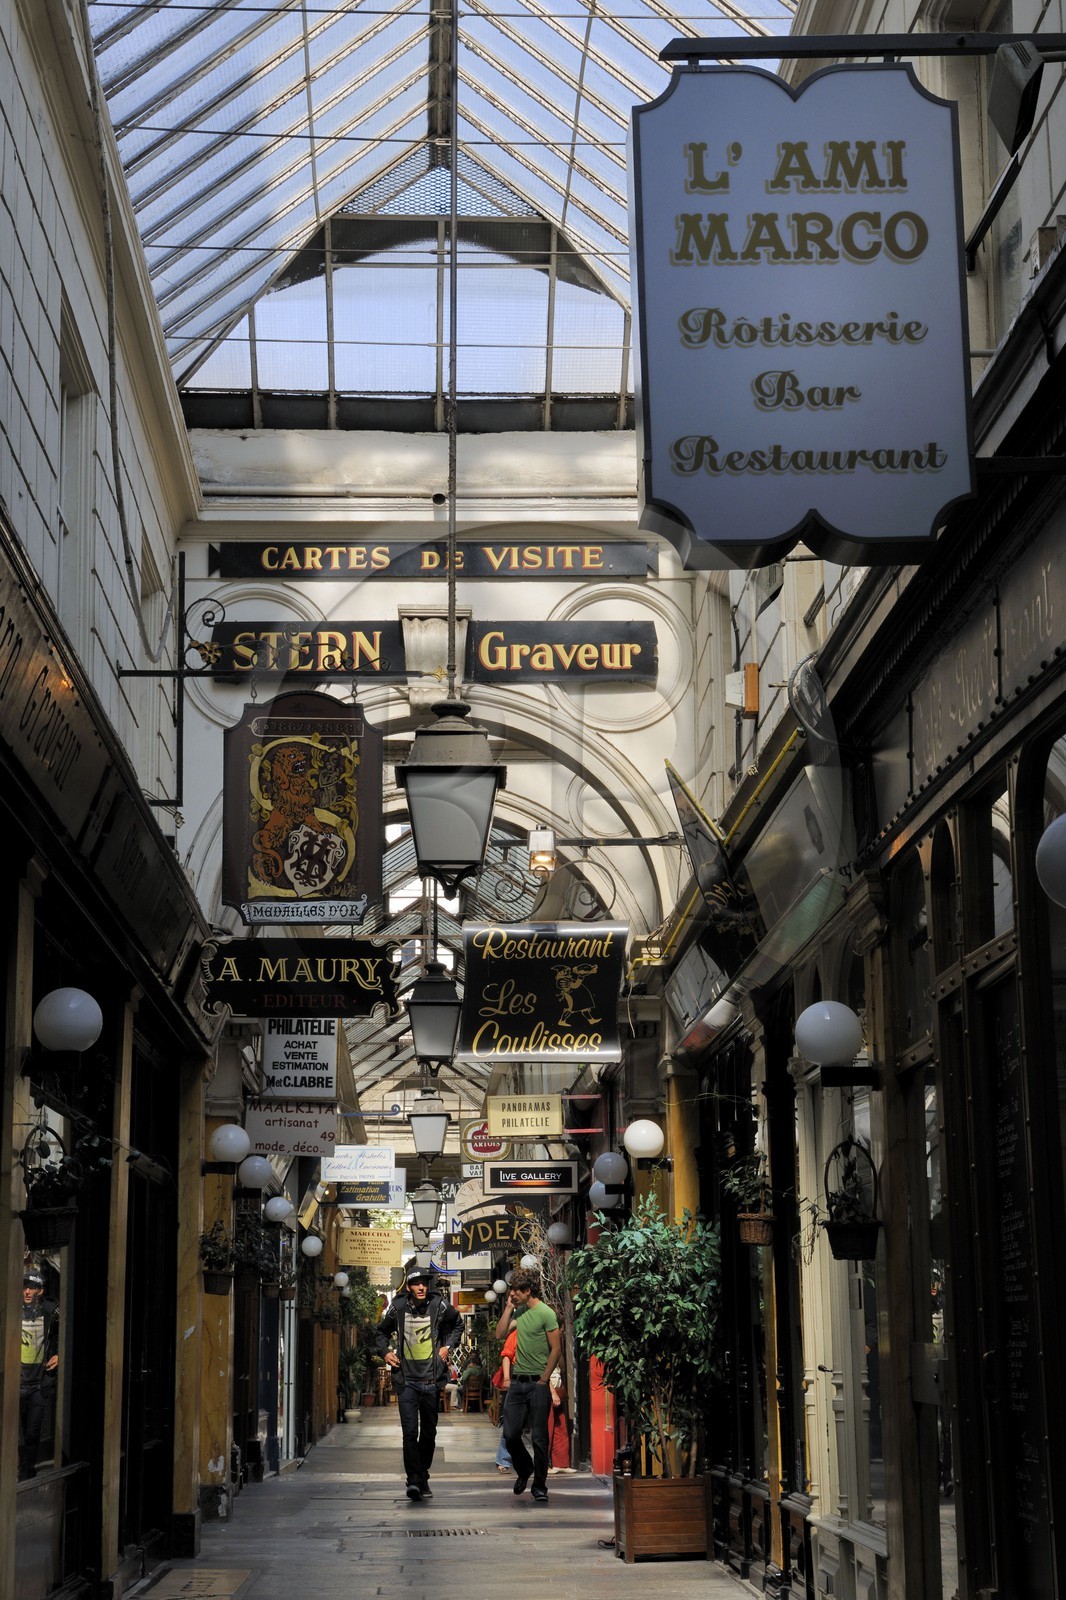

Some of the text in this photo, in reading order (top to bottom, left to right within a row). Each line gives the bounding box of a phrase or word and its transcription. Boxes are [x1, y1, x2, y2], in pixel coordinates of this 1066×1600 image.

[684, 140, 908, 194] L' AMI
[670, 211, 930, 266] MARCO
[678, 306, 929, 349] Rôtisserie
[752, 369, 861, 410] Bar
[671, 435, 949, 477] Restaurant
[261, 546, 391, 571] CARTES
[421, 551, 465, 571] DE
[232, 630, 642, 673] STERN Graveur
[19, 665, 82, 791] Graveur
[252, 904, 361, 918] MEDAILLES D'OR
[472, 927, 613, 959] Restaurant
[256, 957, 384, 995] MAURY
[263, 994, 348, 1008] EDITEUR
[478, 979, 537, 1017] Les
[284, 1041, 318, 1049] ACHAT
[472, 1019, 602, 1058] Coulisses
[284, 1051, 318, 1060] VENTE
[272, 1061, 329, 1071] ESTIMATION
[249, 1100, 334, 1115] MAALKITA
[501, 1102, 551, 1112] PANORAMAS
[265, 1117, 319, 1128] artisanat
[501, 1117, 550, 1128] PHILATELIE
[320, 1131, 336, 1142] 49
[500, 1170, 517, 1183] LIVE
[356, 1194, 387, 1202] Gratuite
